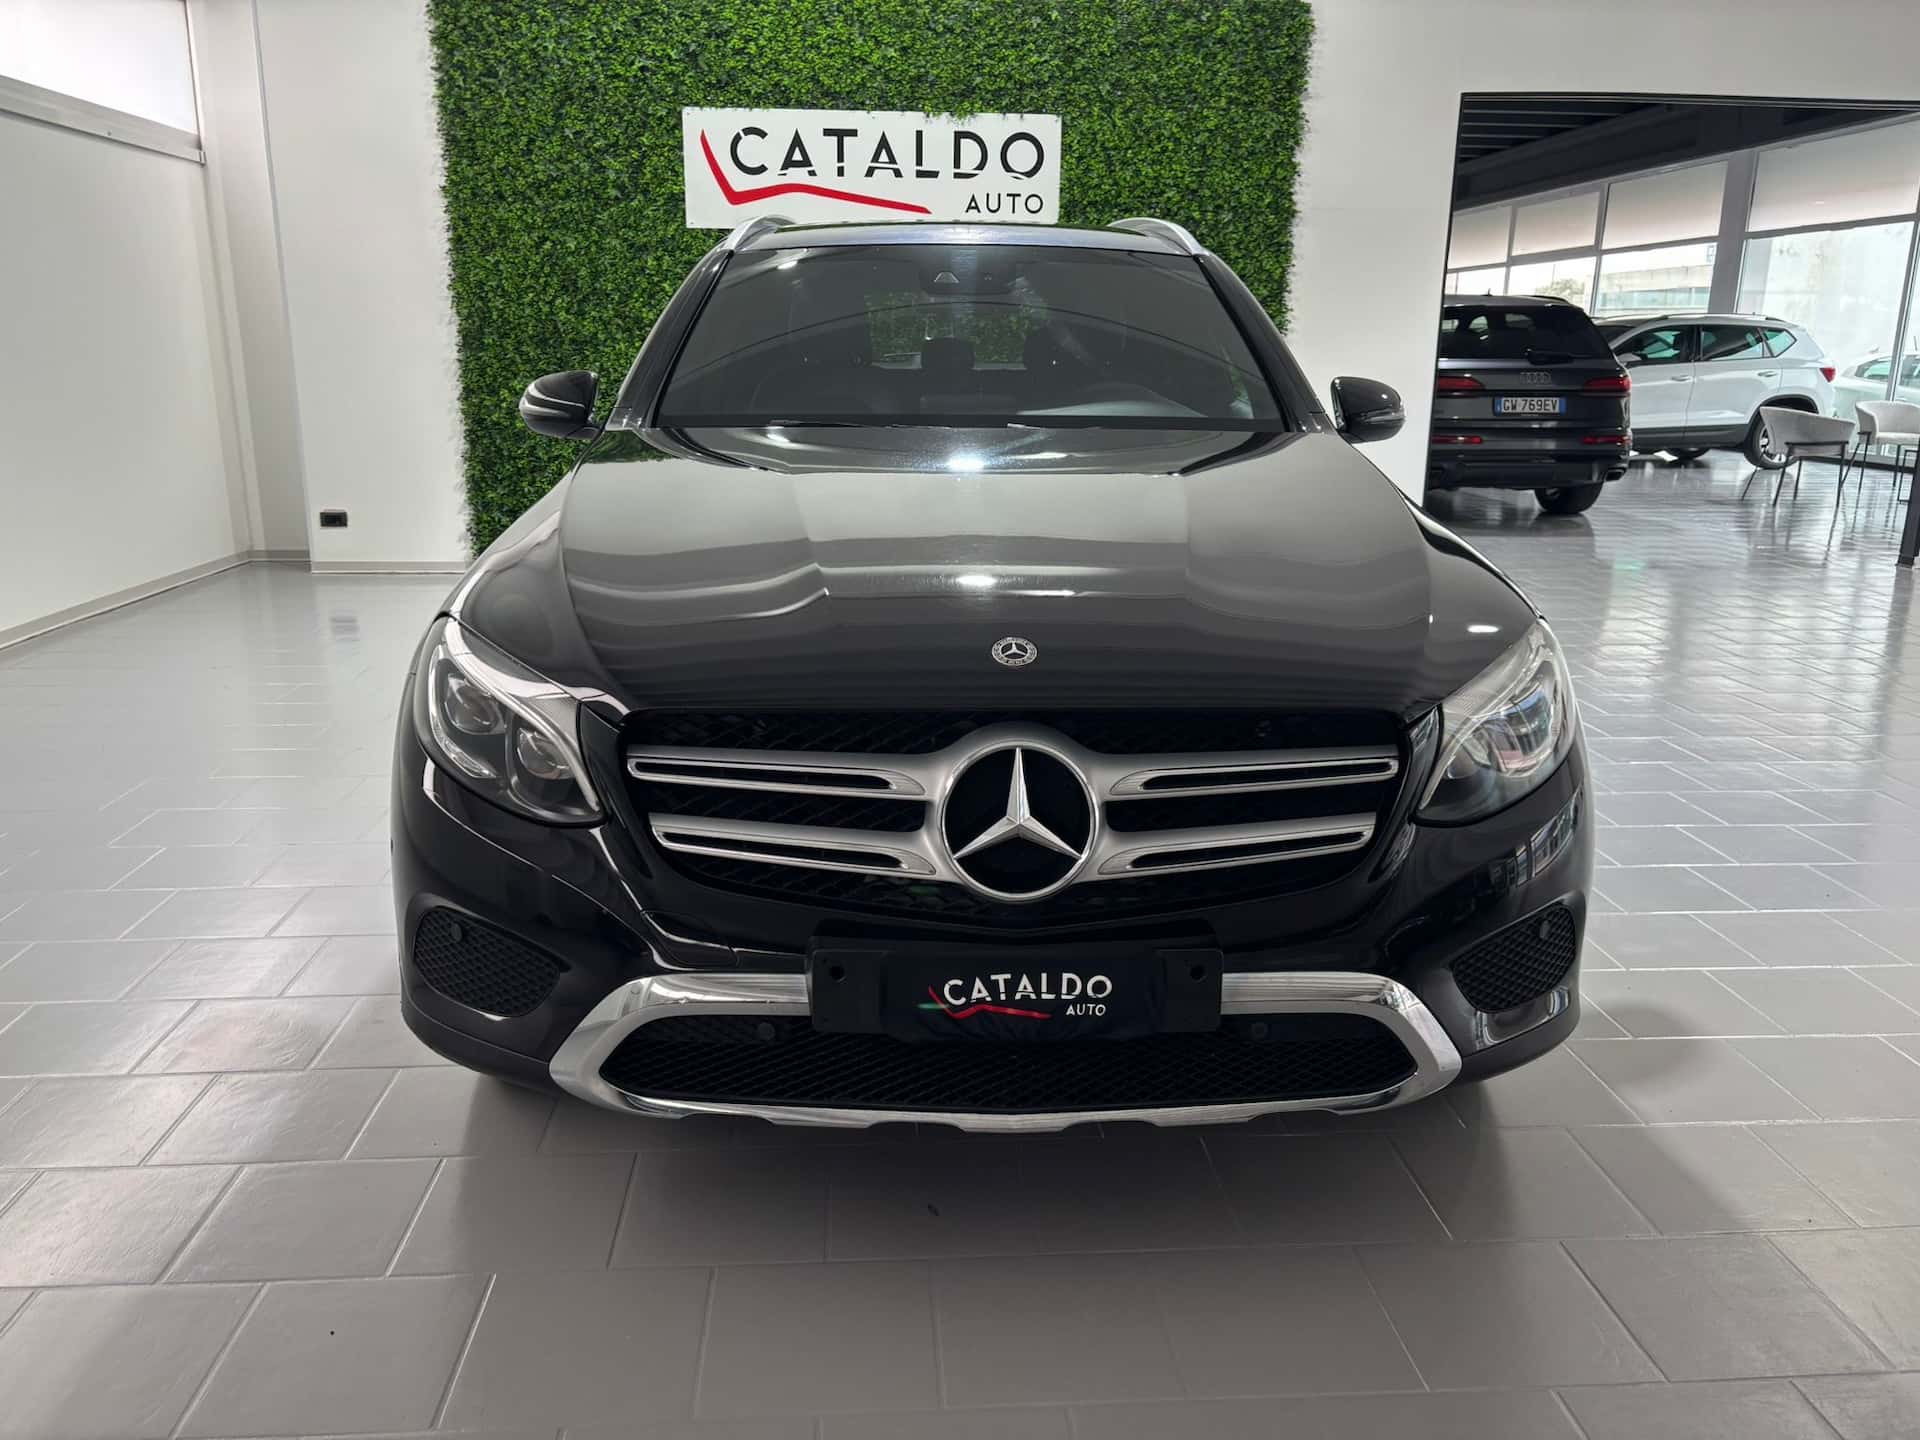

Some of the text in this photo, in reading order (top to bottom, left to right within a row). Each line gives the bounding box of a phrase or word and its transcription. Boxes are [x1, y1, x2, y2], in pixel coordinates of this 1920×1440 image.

[729, 126, 1045, 180] CATALDO
[965, 192, 1044, 215] AUTO
[943, 972, 1113, 1006] CATALDO
[1065, 1003, 1107, 1017] AUTO
